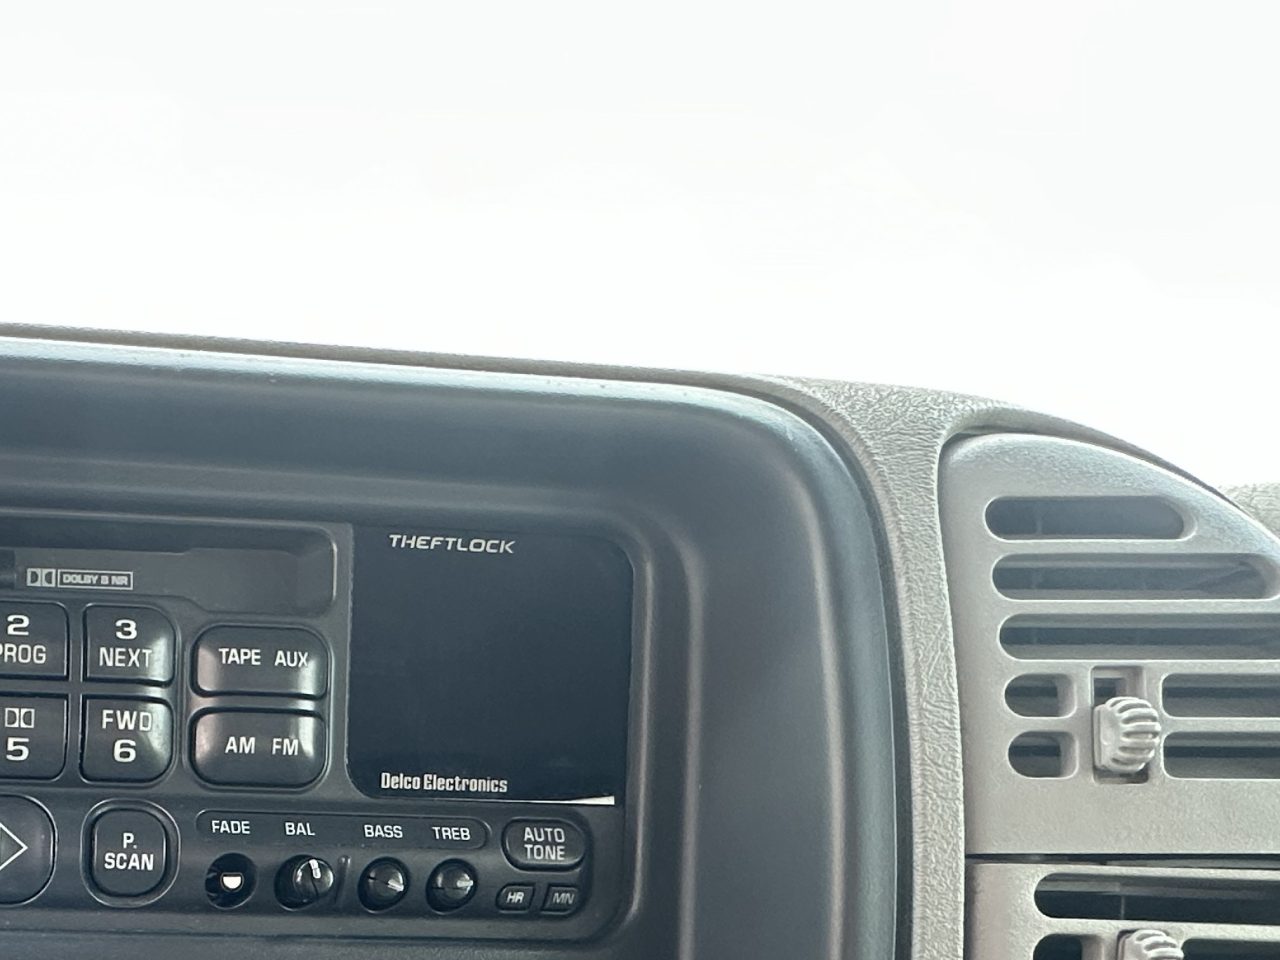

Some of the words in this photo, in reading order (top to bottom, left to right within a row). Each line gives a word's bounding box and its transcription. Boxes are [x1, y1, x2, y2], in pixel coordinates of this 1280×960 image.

[389, 534, 516, 554] THEFTLOCK
[62, 572, 99, 586] DOLBY
[7, 614, 30, 636] 2
[115, 619, 138, 640] 3
[98, 646, 153, 669] NEXT
[218, 647, 261, 666] TAPE
[273, 650, 309, 668] AUX
[101, 709, 153, 732] FWD
[6, 737, 30, 761] 5
[113, 739, 137, 763] 6
[224, 736, 256, 754] AM
[272, 737, 299, 756] FM
[380, 772, 421, 790] Delco
[423, 773, 508, 793] Electronics
[211, 820, 251, 835] FADE
[285, 822, 316, 836] BAL
[363, 824, 403, 839] BASS
[431, 826, 471, 841] TREB
[523, 826, 566, 843] AUTO
[123, 832, 138, 849] P.
[104, 852, 154, 871] SCAN
[523, 843, 566, 861] TONE
[506, 891, 525, 904] HR
[552, 892, 575, 905] MN
